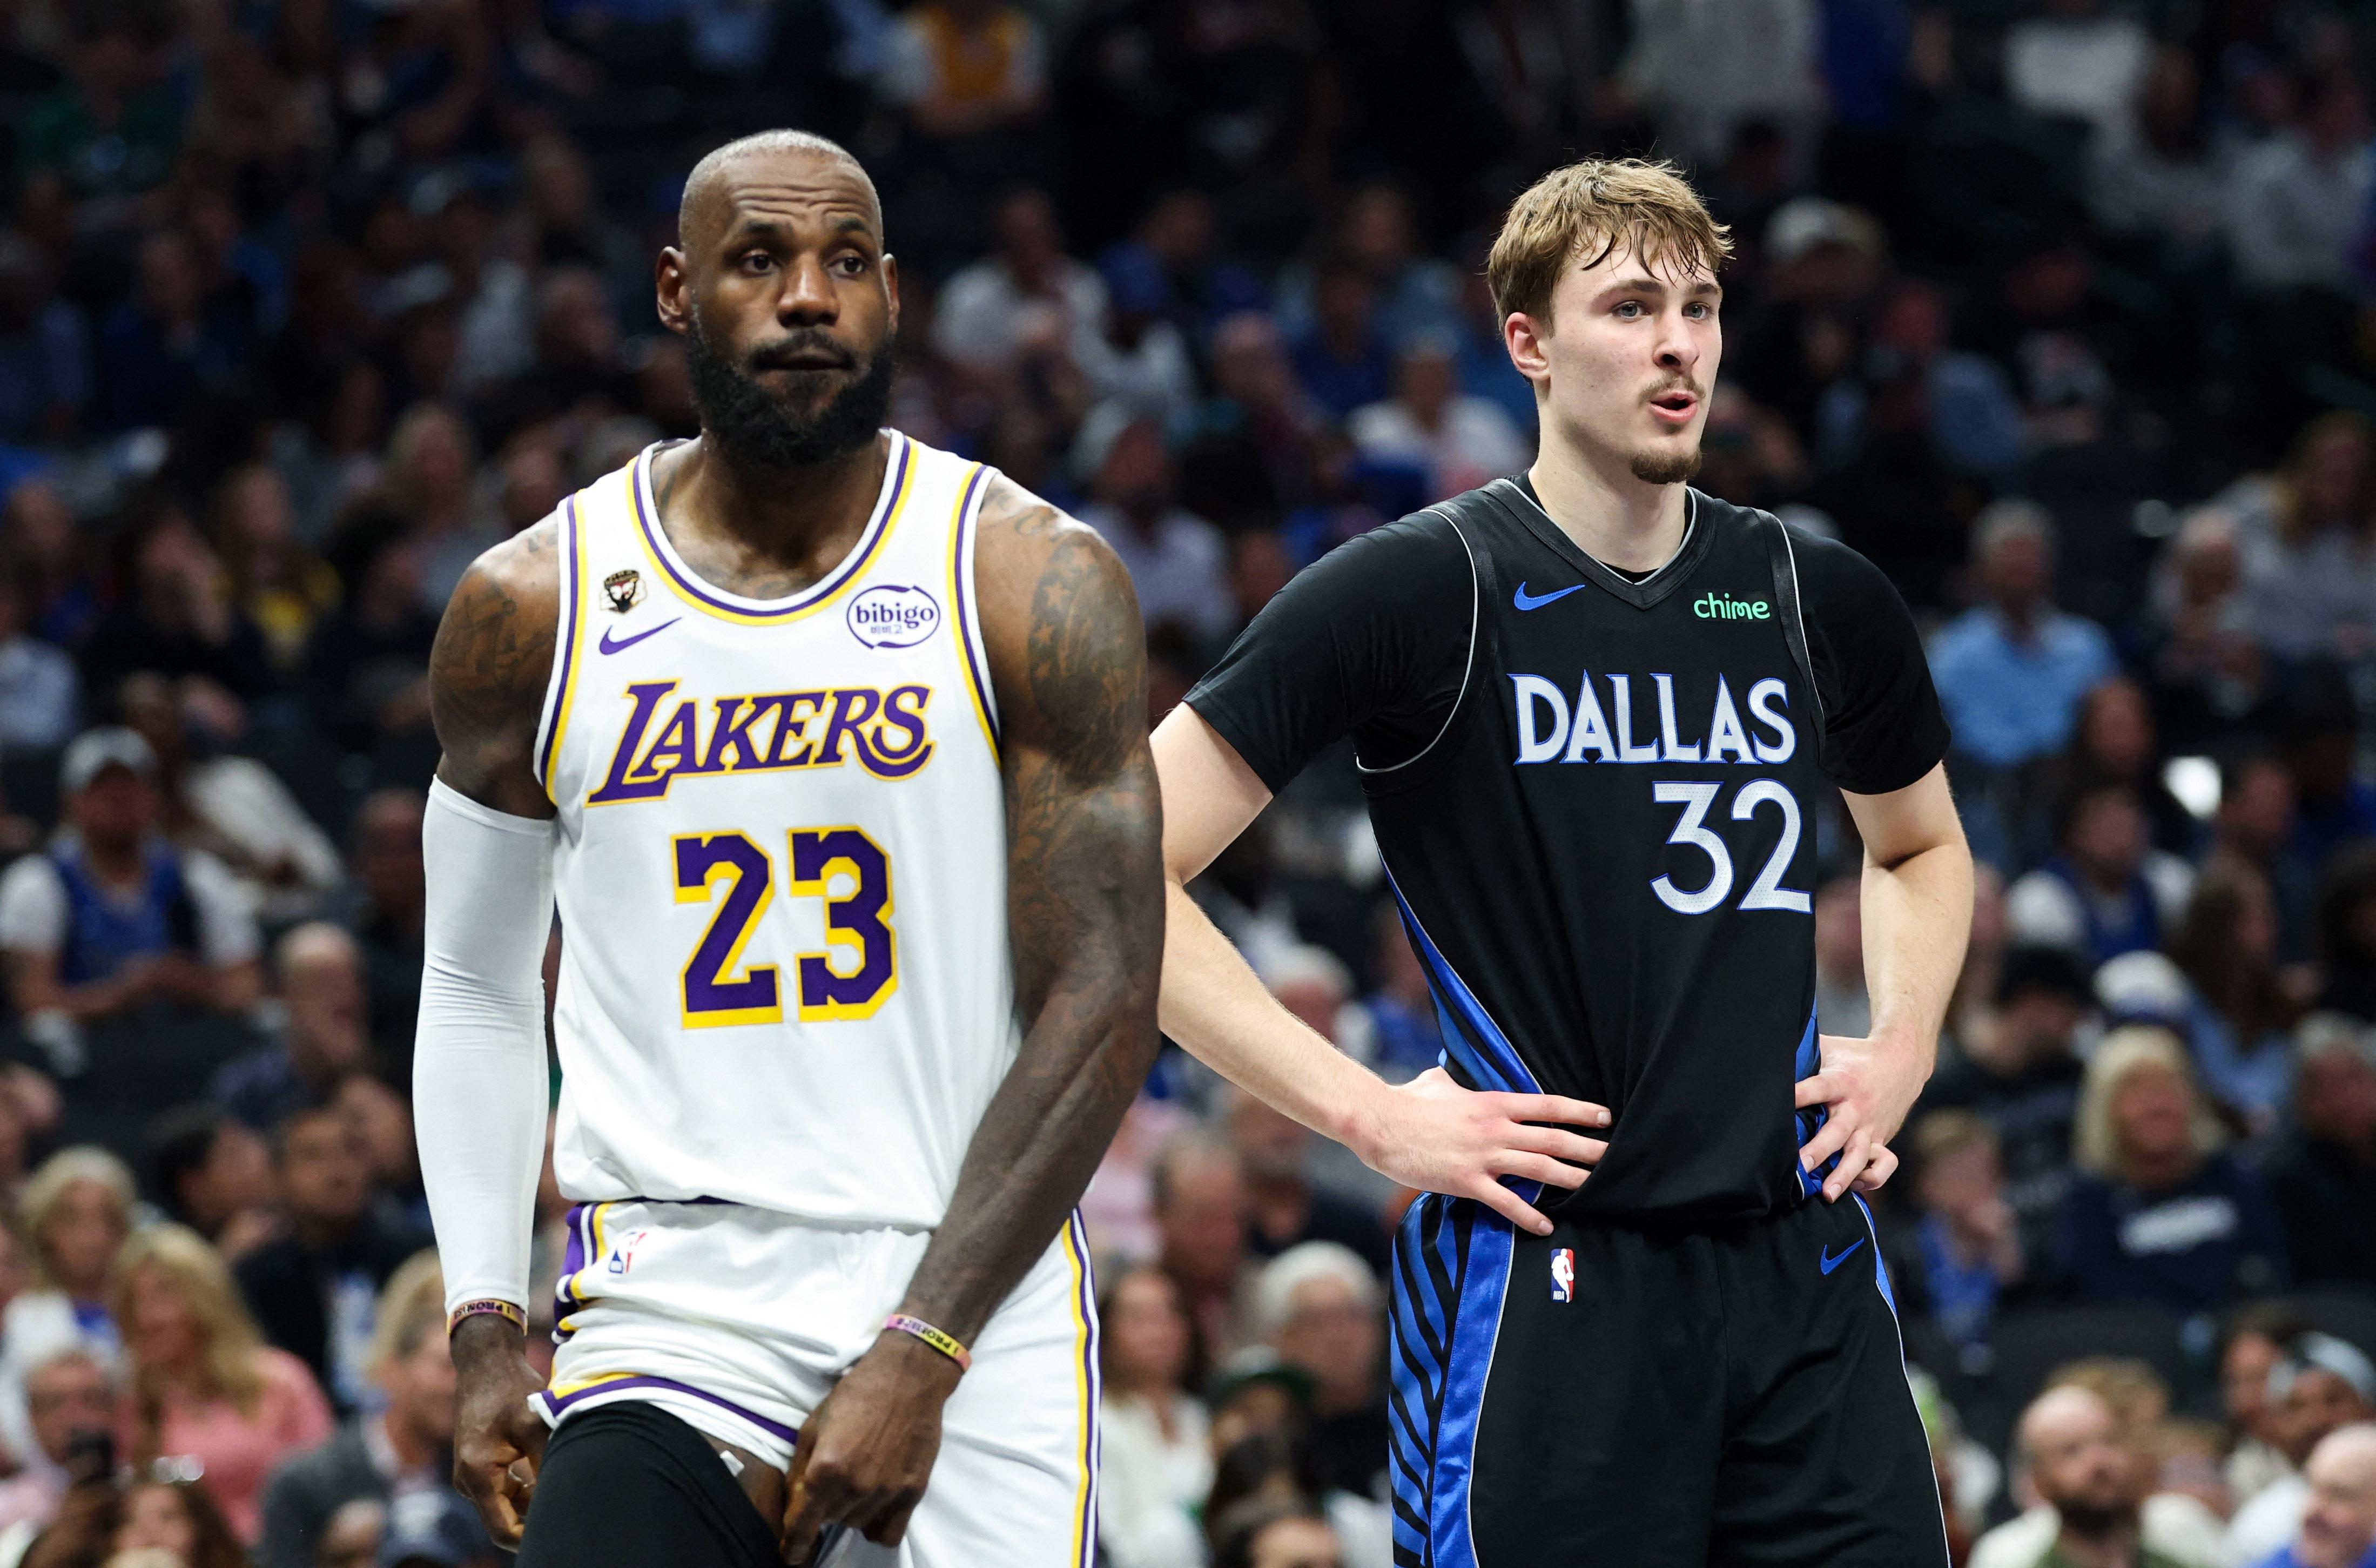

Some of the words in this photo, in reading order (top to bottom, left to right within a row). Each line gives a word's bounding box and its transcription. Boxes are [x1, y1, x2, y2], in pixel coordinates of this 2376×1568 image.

[857, 603, 934, 629] bibigo
[1694, 593, 1770, 619] chime
[583, 678, 938, 808] LAKERS
[1506, 669, 1796, 765] DALLAS
[1650, 778, 1813, 915] 32
[670, 825, 898, 1029] 23
[1553, 1290, 1564, 1300] NBA
